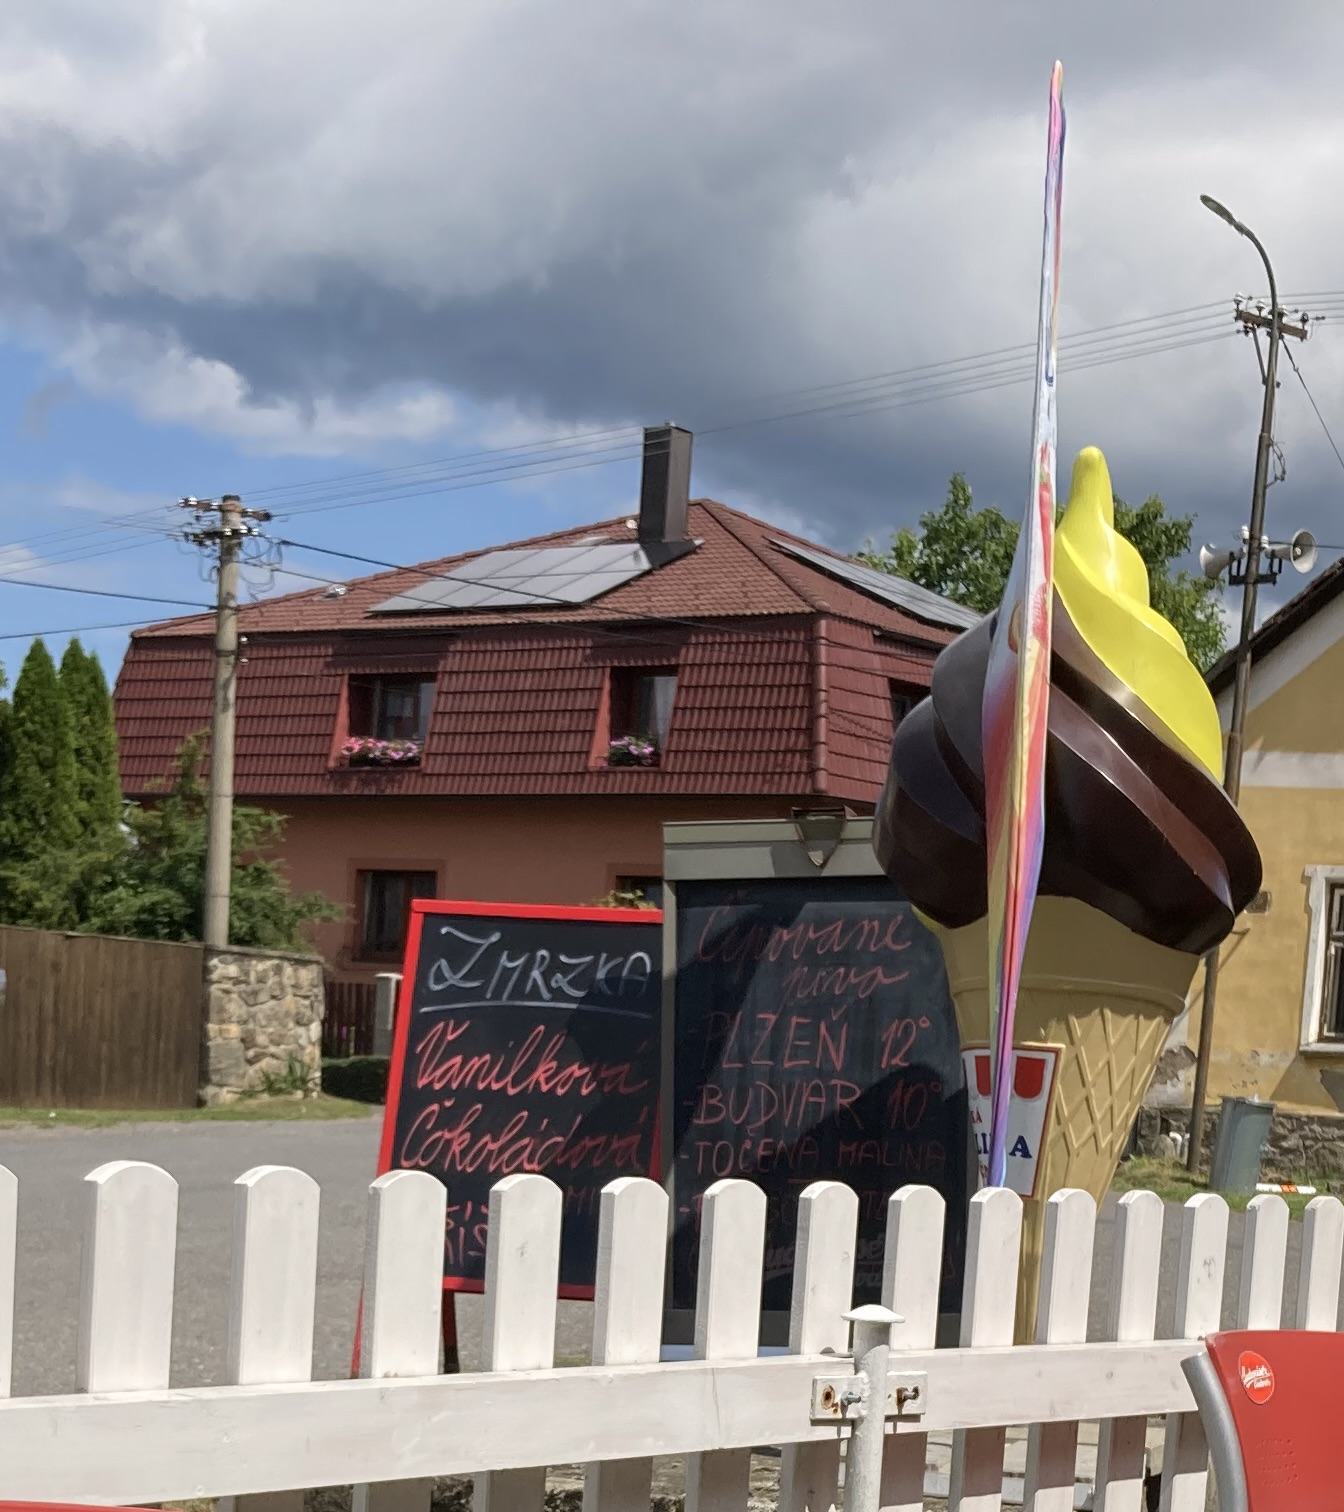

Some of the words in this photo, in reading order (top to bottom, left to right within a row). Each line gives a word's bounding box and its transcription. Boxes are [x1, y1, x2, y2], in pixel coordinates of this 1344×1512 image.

[426, 925, 654, 1001] ZMRZKA
[414, 1018, 650, 1098] Vanilková
[700, 1006, 849, 1073] PLZEŇ
[879, 1015, 932, 1070] 12°
[399, 1096, 645, 1174] Čokoládová
[692, 1078, 868, 1131] BUDVAR
